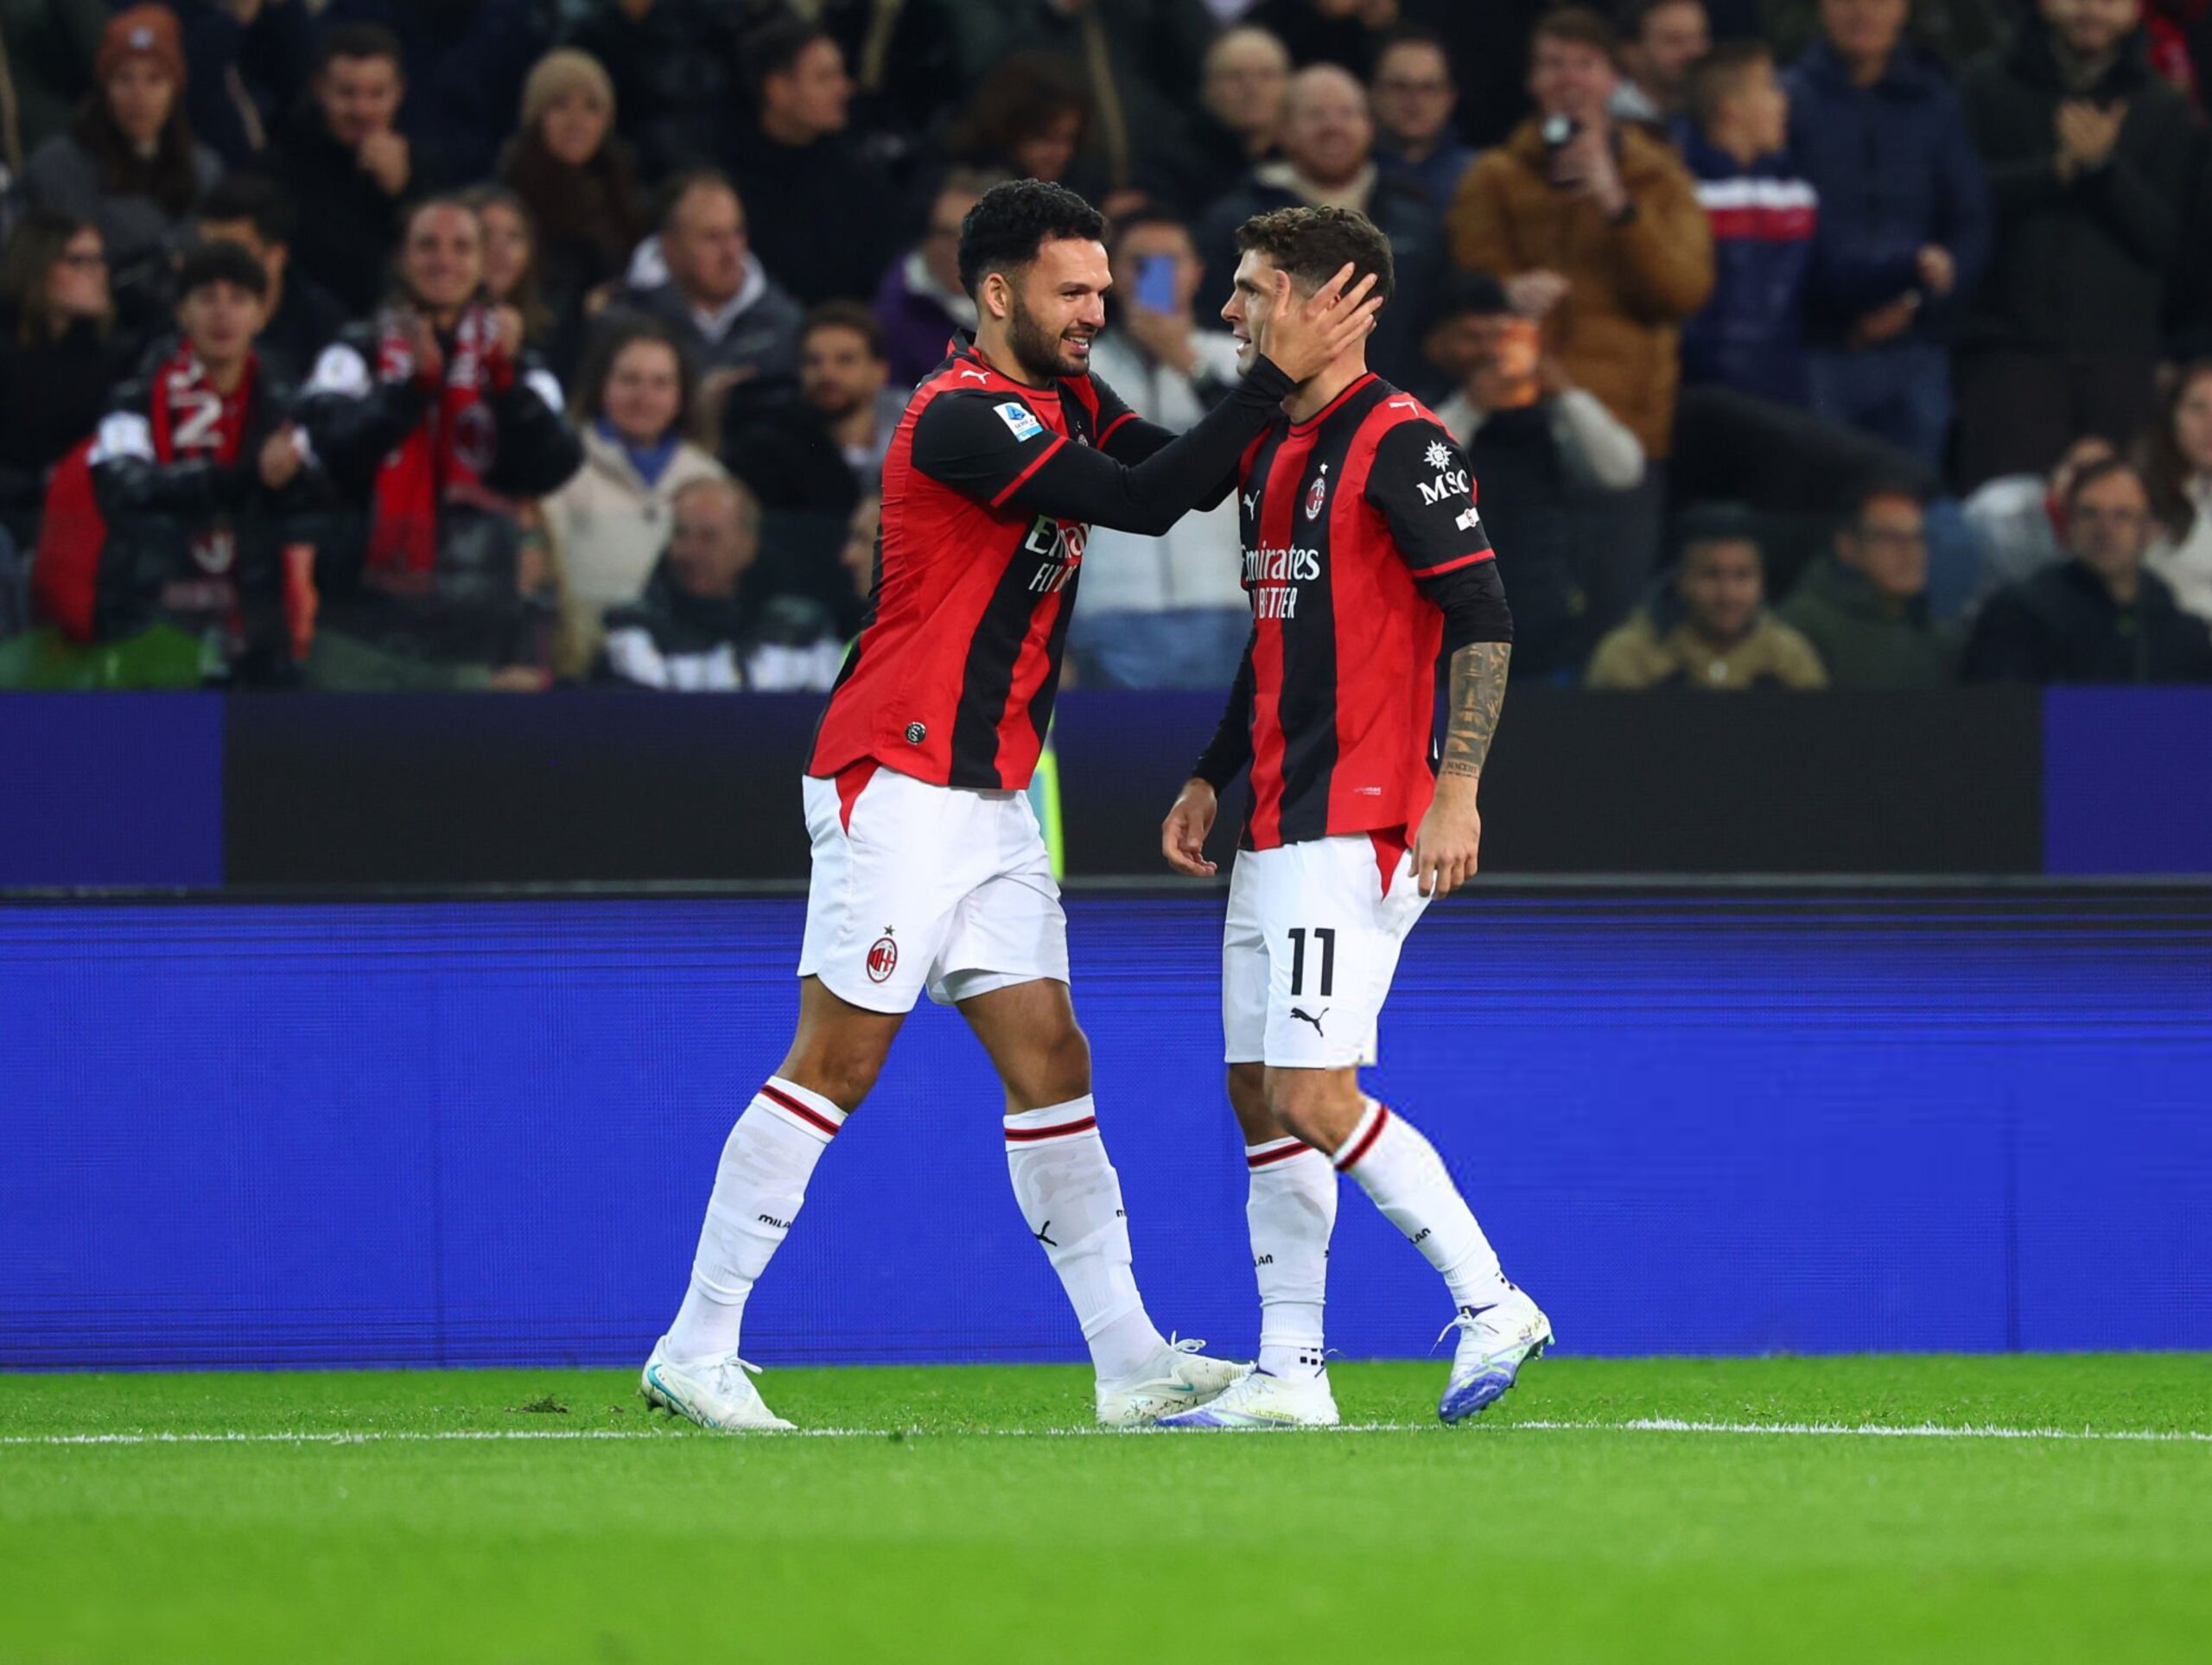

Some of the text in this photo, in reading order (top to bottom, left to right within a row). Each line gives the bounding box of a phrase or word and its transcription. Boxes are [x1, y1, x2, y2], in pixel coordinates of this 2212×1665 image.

[1415, 469, 1470, 506] MSC
[1242, 539, 1321, 581] mirates
[1287, 927, 1336, 997] 11
[758, 1214, 791, 1229] MILA
[1408, 1228, 1432, 1244] LAN
[1253, 1254, 1274, 1268] LAN
